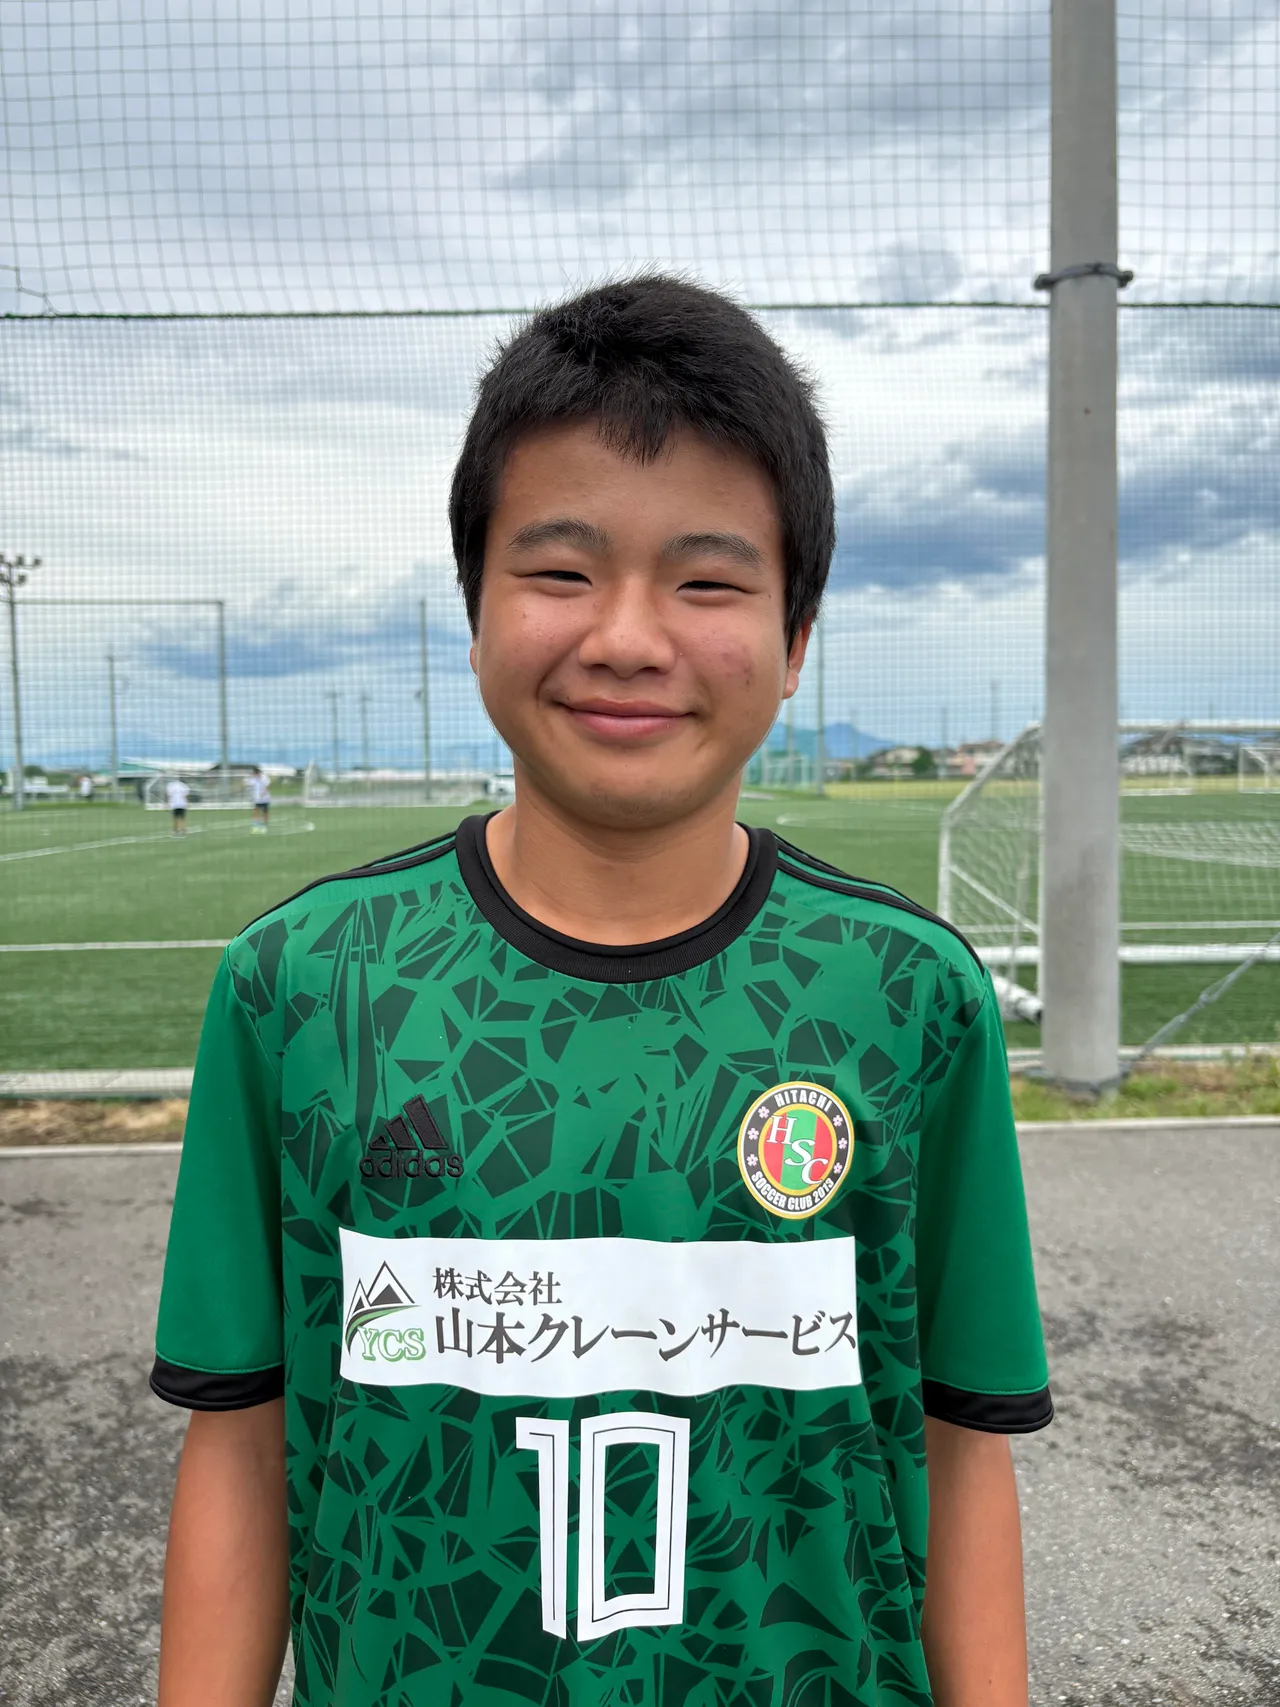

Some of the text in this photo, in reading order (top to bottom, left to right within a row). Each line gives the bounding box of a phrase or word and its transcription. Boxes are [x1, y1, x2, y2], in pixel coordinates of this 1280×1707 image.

[774, 1089, 833, 1112] HITACHI
[359, 1149, 464, 1178] adidas
[751, 1170, 835, 1211] SOCCER CLUB 2013
[432, 1267, 563, 1306] 株式会社
[357, 1326, 427, 1362] YCS
[435, 1306, 857, 1364] 山本クレーンサービス
[515, 1411, 691, 1642] 10
